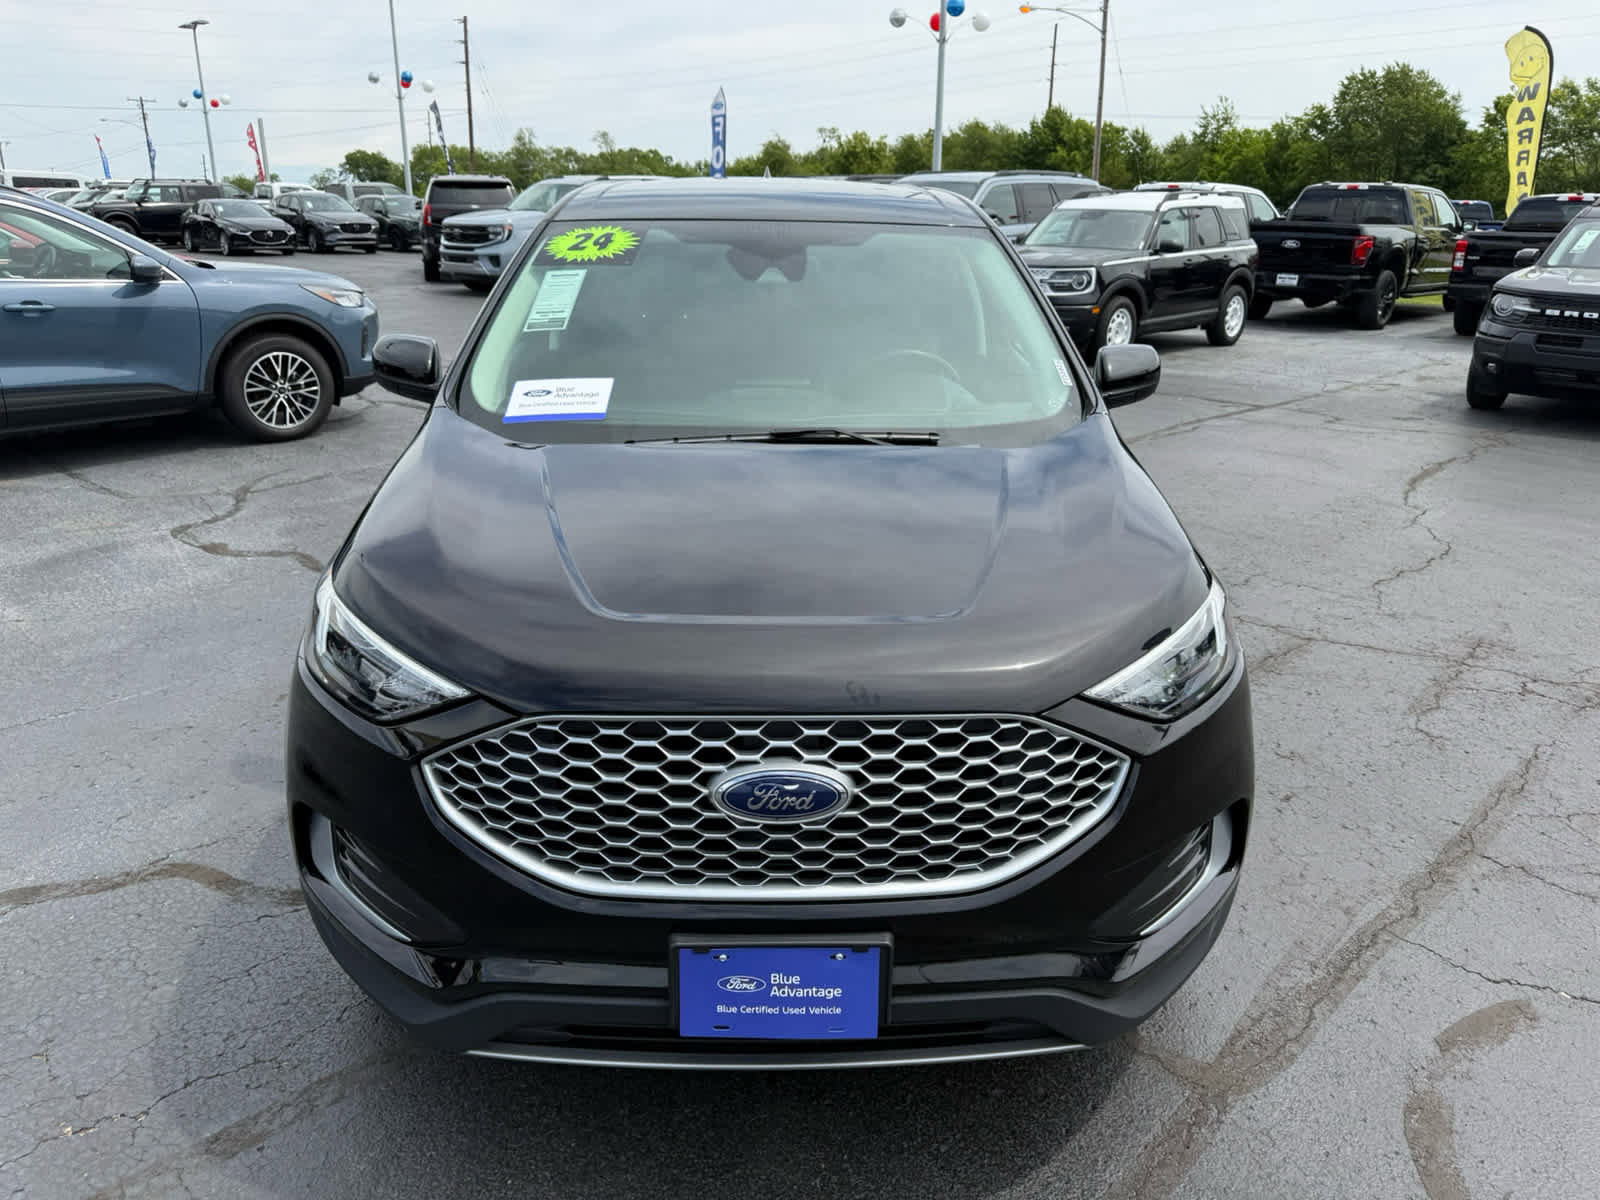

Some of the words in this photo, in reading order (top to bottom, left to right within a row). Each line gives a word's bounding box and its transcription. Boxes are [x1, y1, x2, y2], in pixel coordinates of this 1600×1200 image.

[567, 232, 614, 251] 24
[747, 783, 816, 810] Ford
[726, 978, 757, 991] Ford
[770, 973, 801, 985] Blue
[770, 986, 842, 1000] Advantage
[716, 1004, 737, 1014] Blue
[740, 1005, 779, 1015] Certified
[782, 1006, 806, 1015] Used
[809, 1006, 842, 1015] Vehicle
